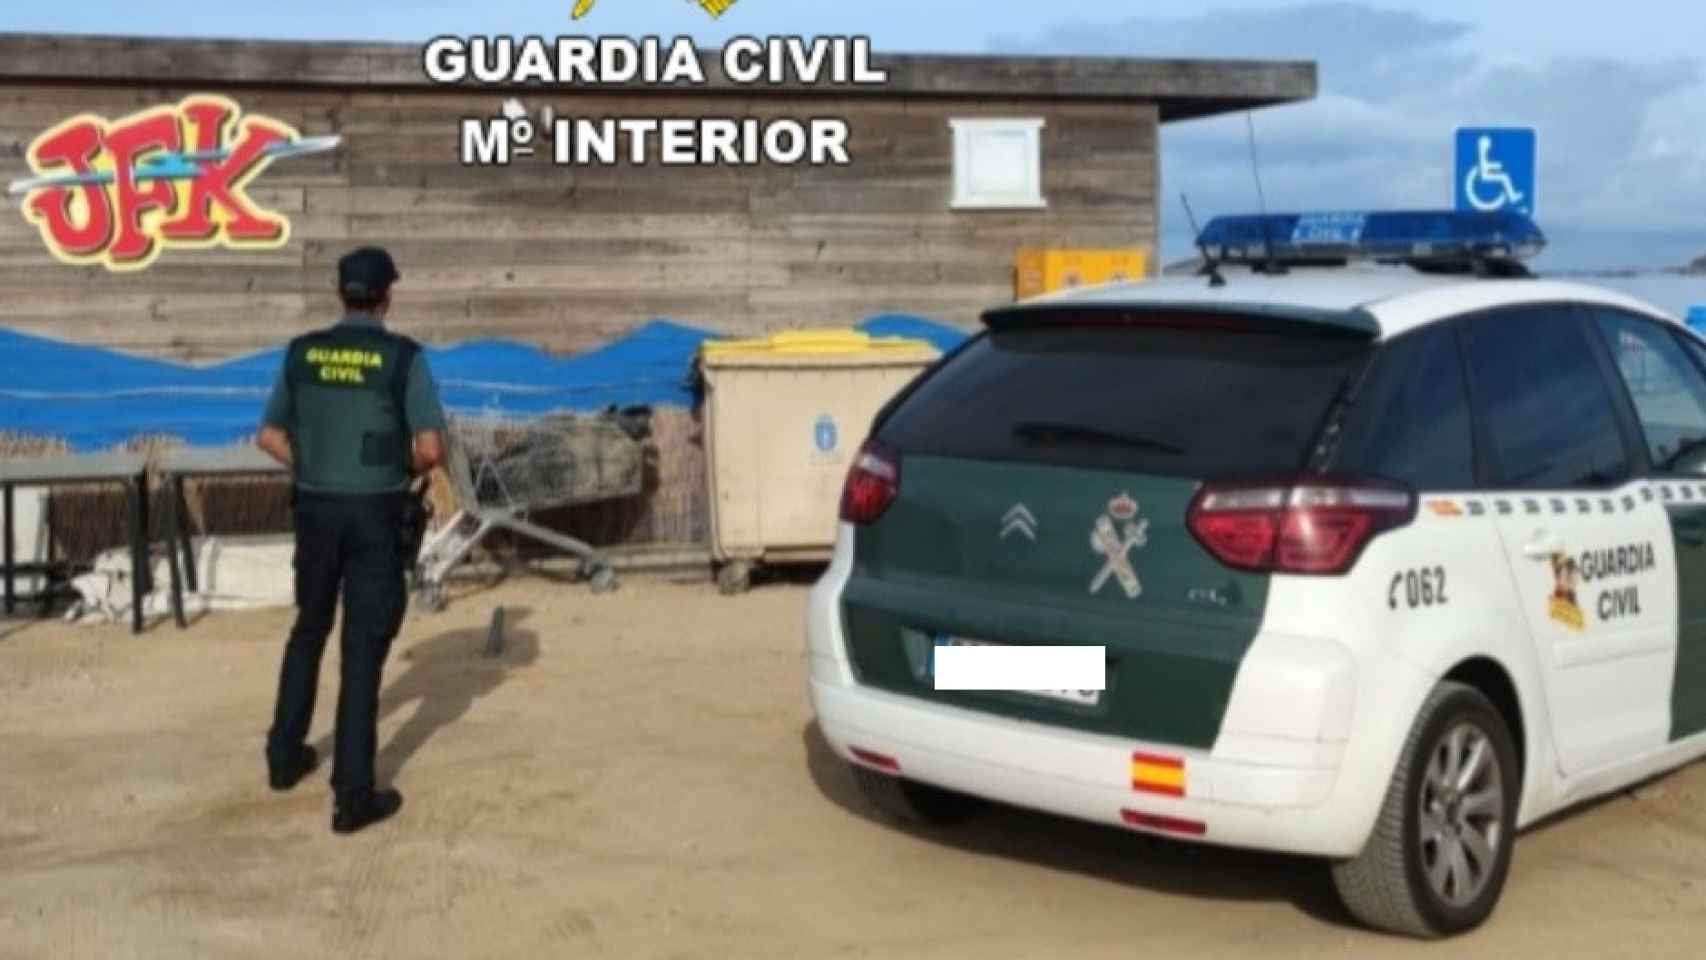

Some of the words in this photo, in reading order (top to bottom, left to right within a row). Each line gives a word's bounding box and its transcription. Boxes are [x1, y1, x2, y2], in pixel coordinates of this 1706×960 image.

[25, 97, 293, 262] JFK
[305, 349, 382, 368] GUARDIA
[320, 366, 364, 381] CIVIL
[1580, 541, 1655, 581] GUARDIA
[1406, 566, 1447, 609] 062
[1597, 587, 1640, 620] CIVIL
